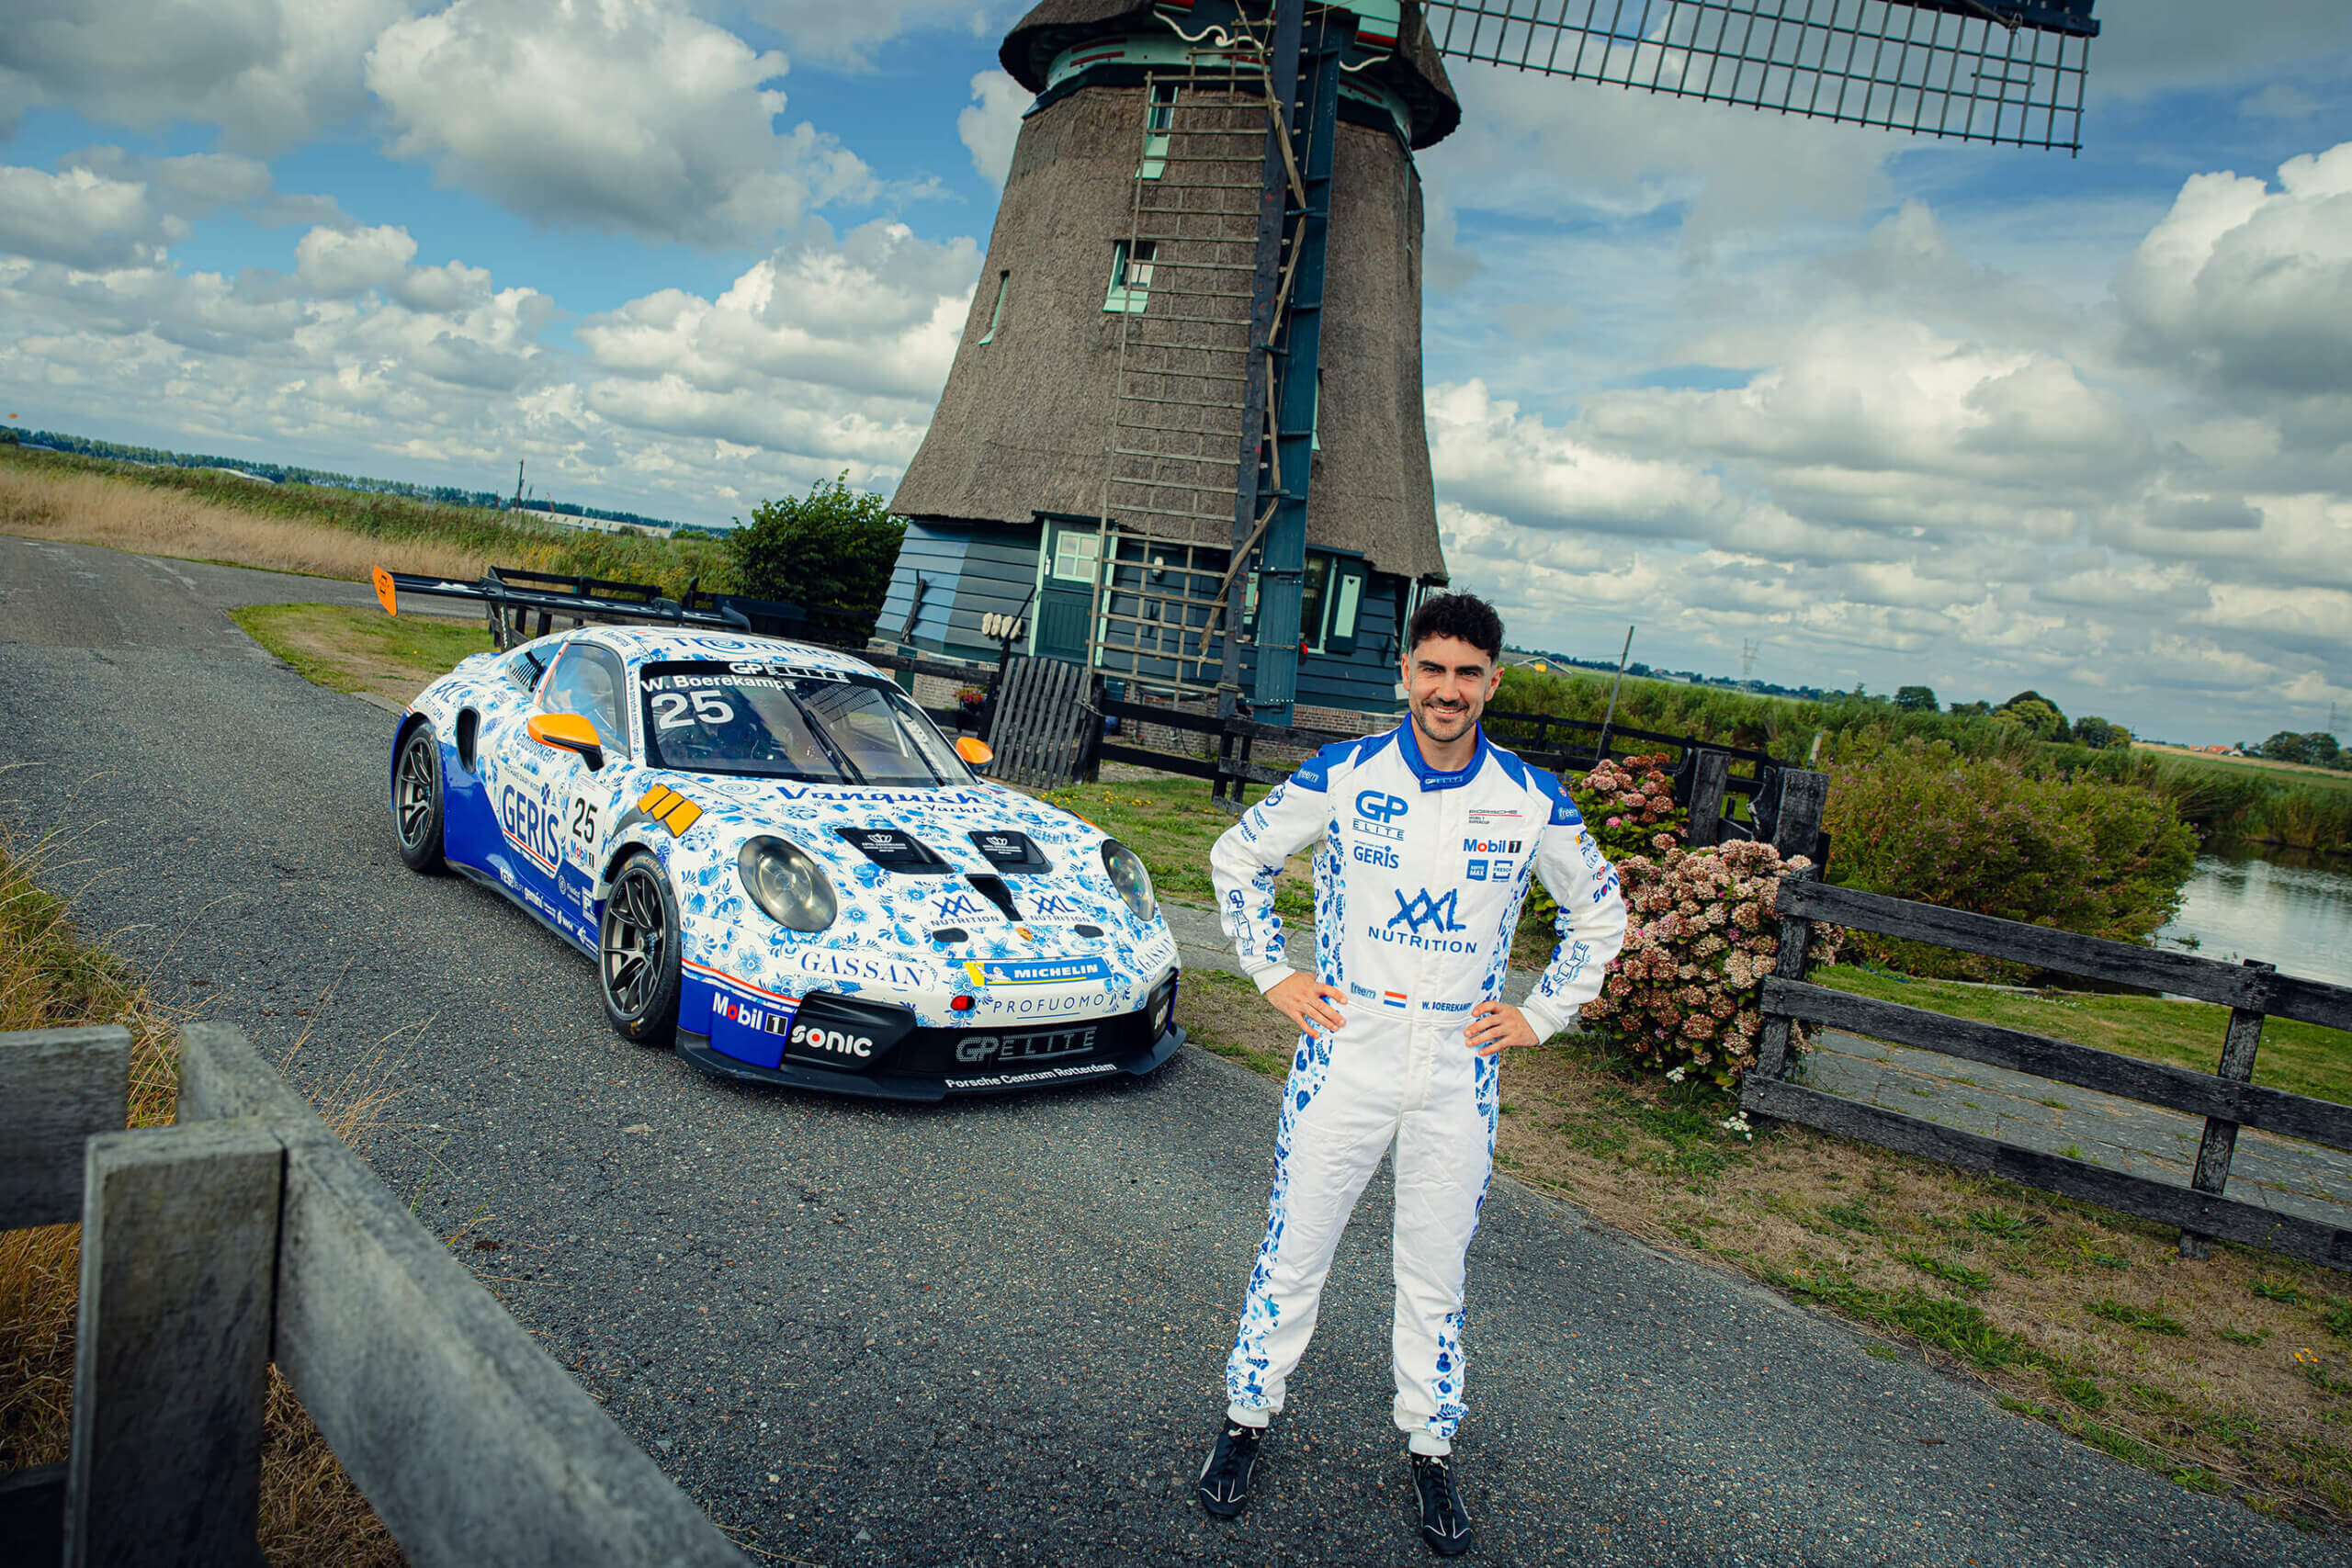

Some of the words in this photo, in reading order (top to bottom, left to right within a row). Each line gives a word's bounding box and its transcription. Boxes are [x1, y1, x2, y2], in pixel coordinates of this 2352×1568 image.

[673, 675, 797, 691] Boerekamps
[650, 690, 734, 730] 25
[775, 785, 984, 805] Vanquish
[1355, 789, 1408, 823] GP
[503, 782, 559, 865] GERIS
[572, 797, 598, 843] 25
[1352, 818, 1404, 840] ELITE
[1353, 845, 1399, 869] GERIS
[1463, 839, 1506, 852] Mobil
[932, 894, 985, 919] XXL
[1028, 895, 1076, 915] XXL
[1387, 887, 1466, 934] XXL
[930, 916, 1000, 926] NUTRITION
[1368, 926, 1477, 953] NUTRITION
[800, 950, 924, 987] GASSAN
[1013, 964, 1100, 979] MICHELIN
[712, 992, 763, 1030] Mobil
[992, 993, 1104, 1014] PROFUOMO
[944, 1075, 1001, 1091] Porsche
[1001, 1069, 1056, 1086] Centrum
[1055, 1063, 1118, 1079] Rotterdam
